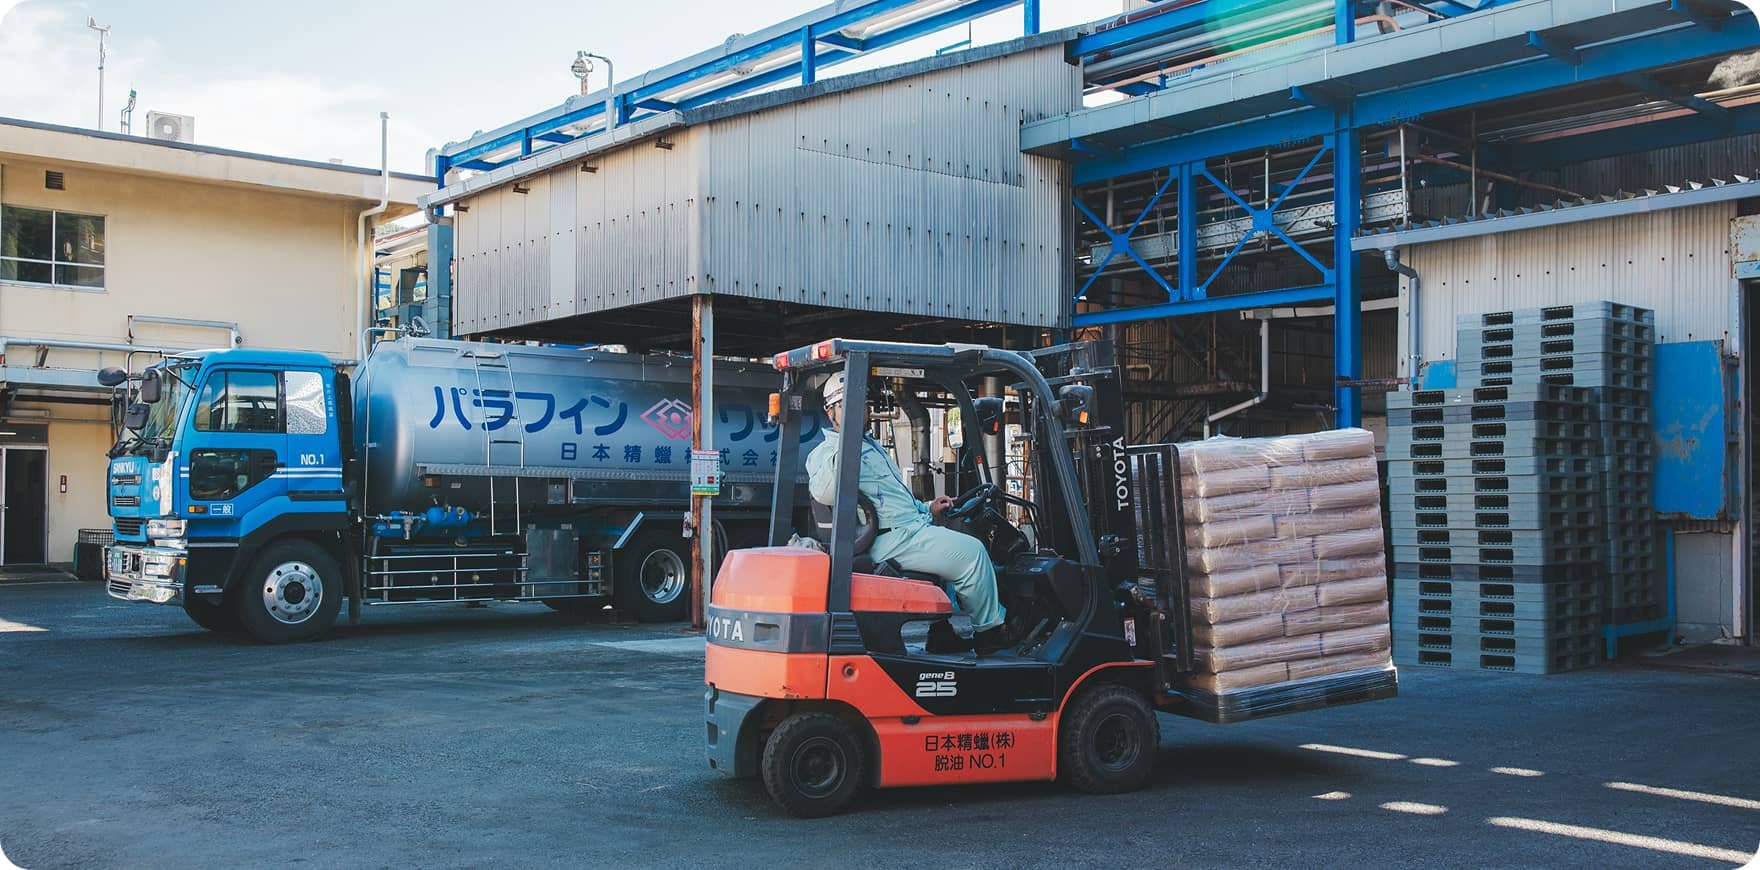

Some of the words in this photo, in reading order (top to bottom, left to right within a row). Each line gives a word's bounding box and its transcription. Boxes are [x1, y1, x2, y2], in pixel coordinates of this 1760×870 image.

[300, 454, 324, 465] NO.1
[1112, 436, 1129, 511] TOYOTA
[916, 681, 957, 697] 25
[935, 754, 964, 772] 脱油
[969, 753, 1005, 769] NO.1
